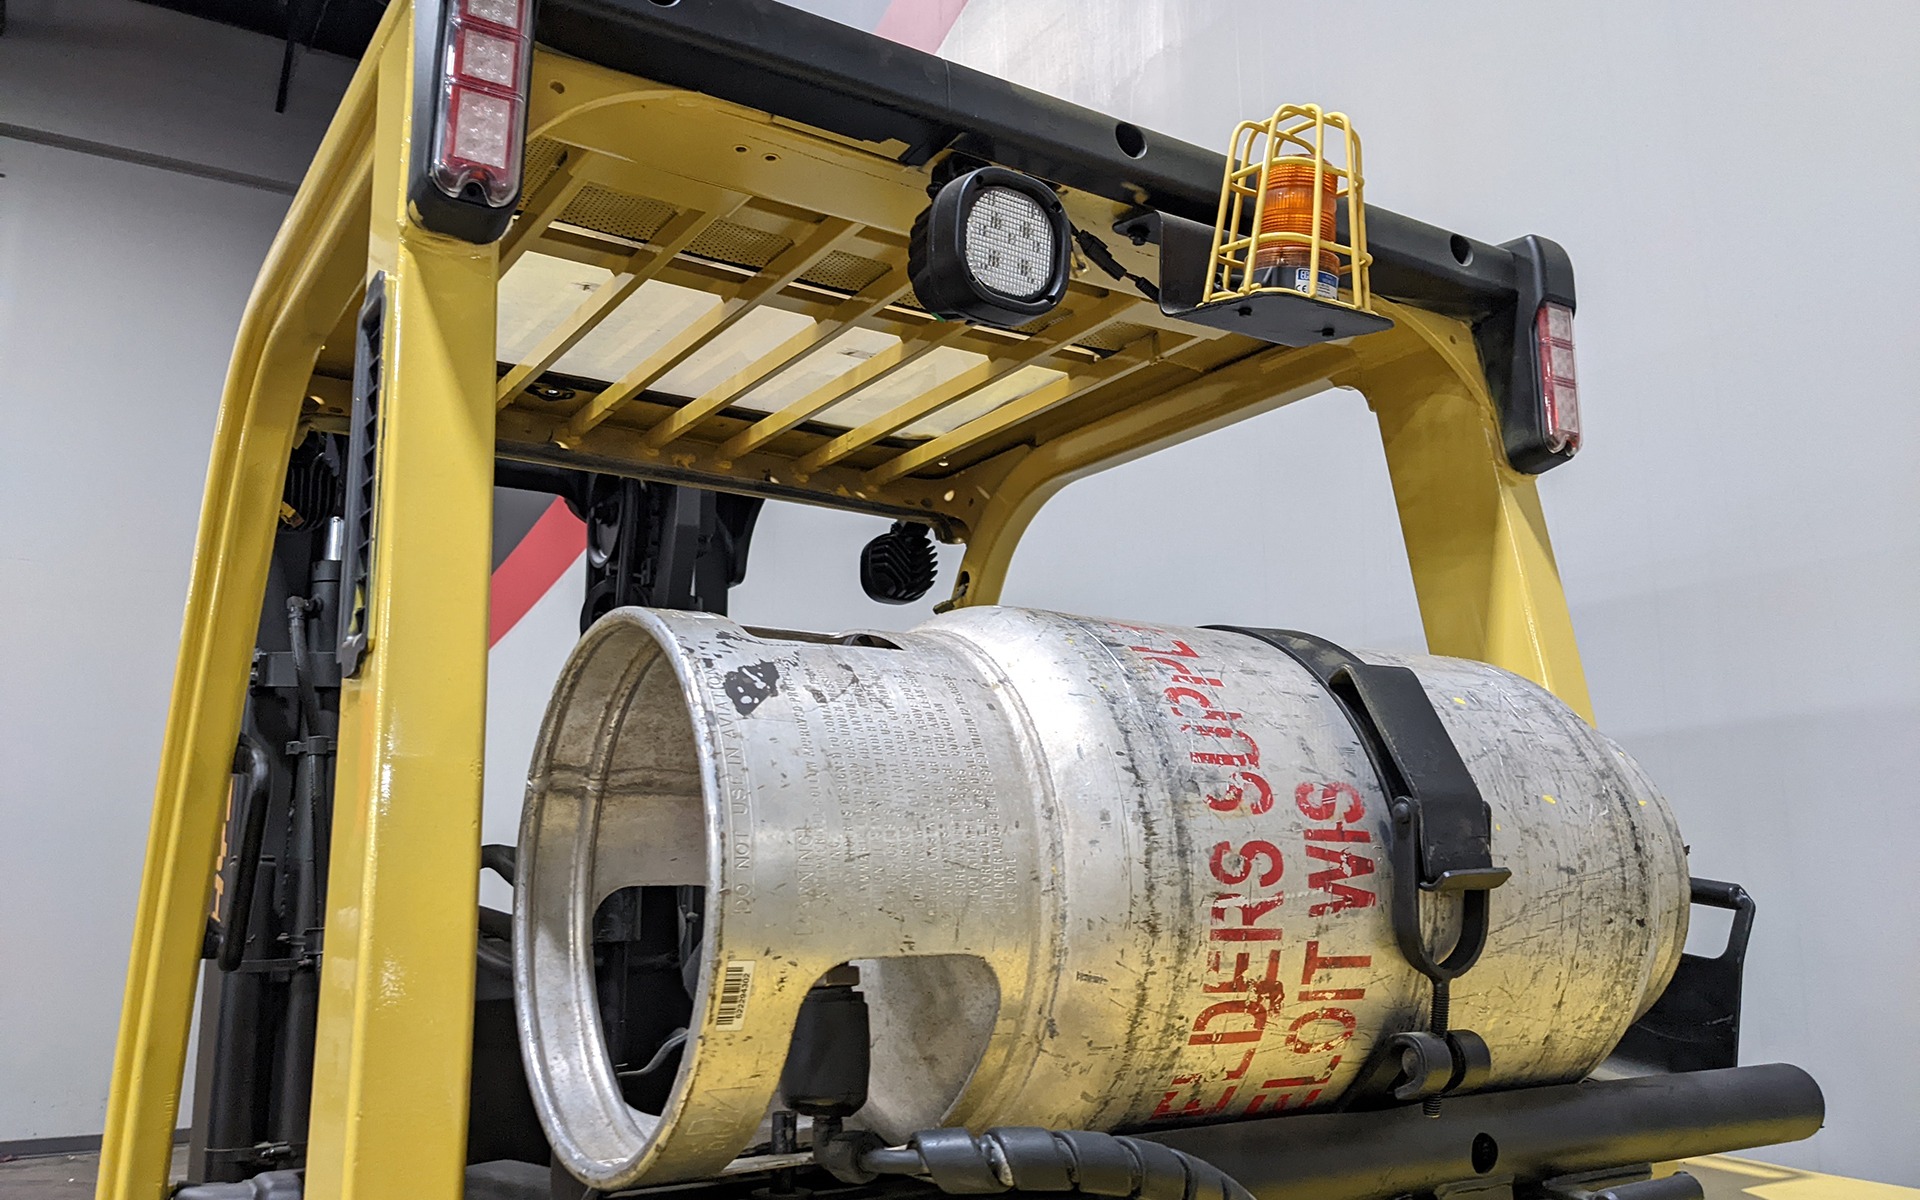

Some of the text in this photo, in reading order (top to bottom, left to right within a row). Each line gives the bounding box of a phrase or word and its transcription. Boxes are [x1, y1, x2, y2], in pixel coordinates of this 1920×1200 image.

[724, 748, 741, 765] IN
[729, 776, 748, 815] USE
[734, 832, 750, 869] NOT
[1244, 780, 1377, 1115] ELOIT WIS
[1151, 840, 1284, 1119] ELDERS
